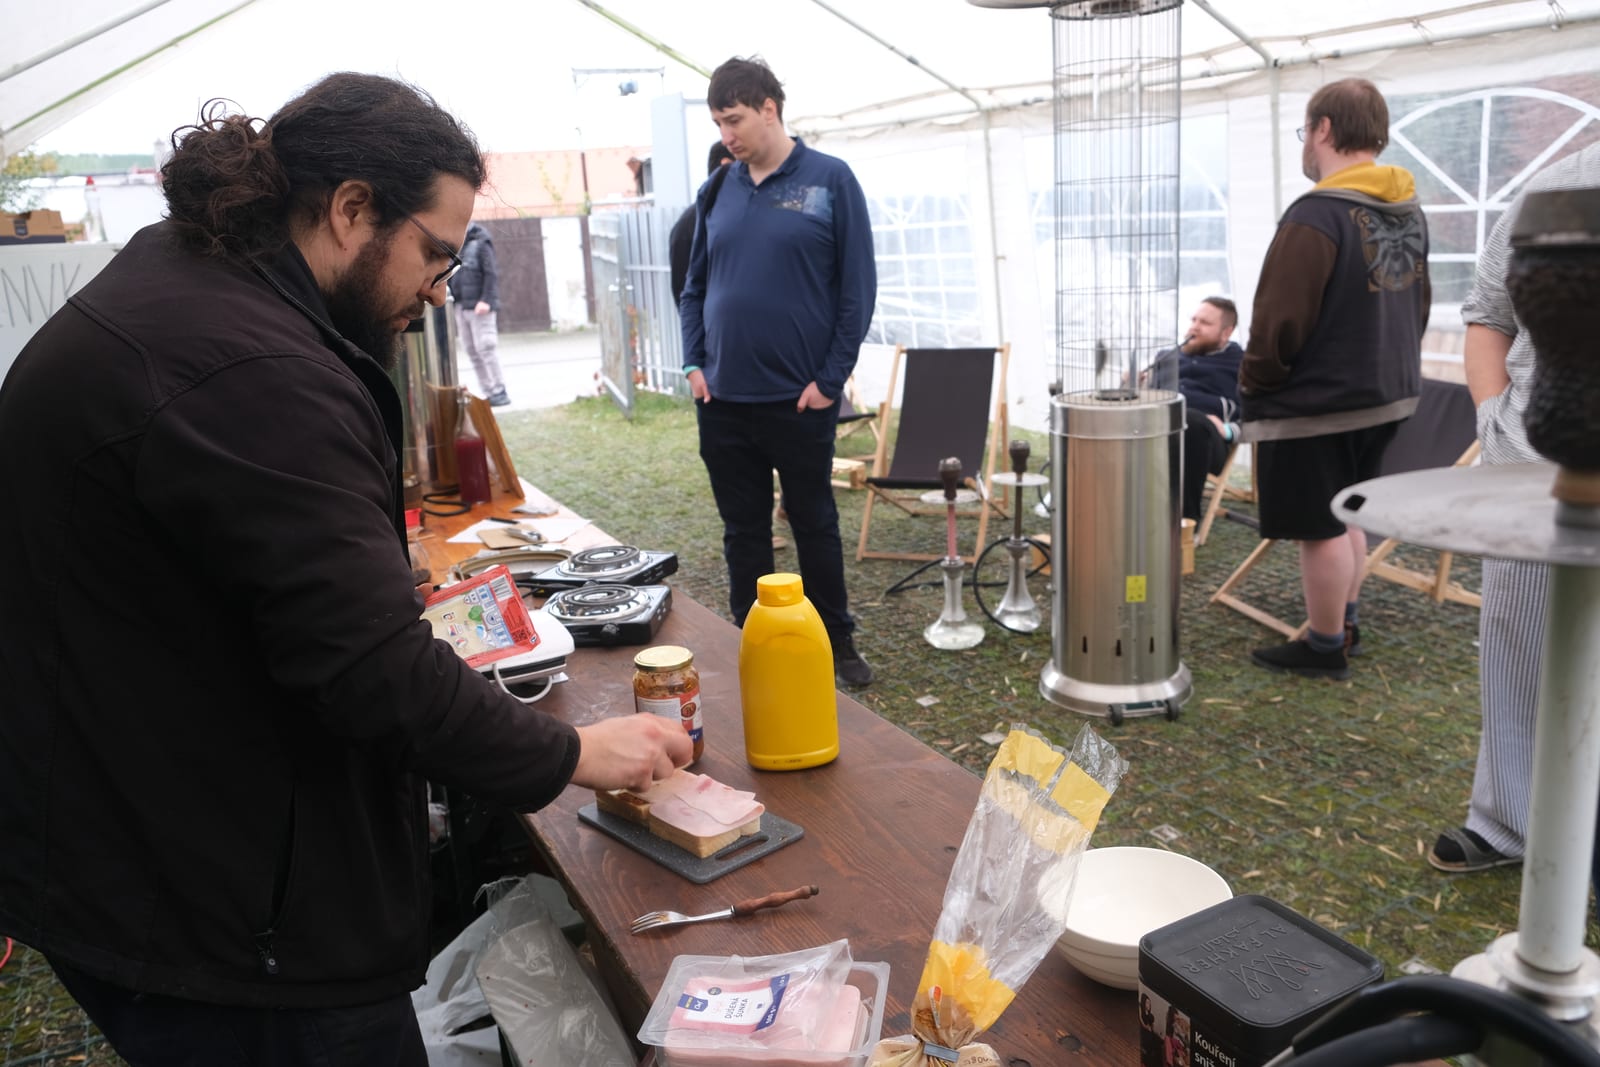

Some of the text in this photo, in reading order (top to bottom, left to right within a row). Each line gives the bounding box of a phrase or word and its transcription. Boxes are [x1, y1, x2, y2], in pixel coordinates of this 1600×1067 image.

[1182, 923, 1289, 974] AL FAKHER
[734, 998, 749, 1018] ŠUNKA
[1195, 1031, 1237, 1067] Kouření
